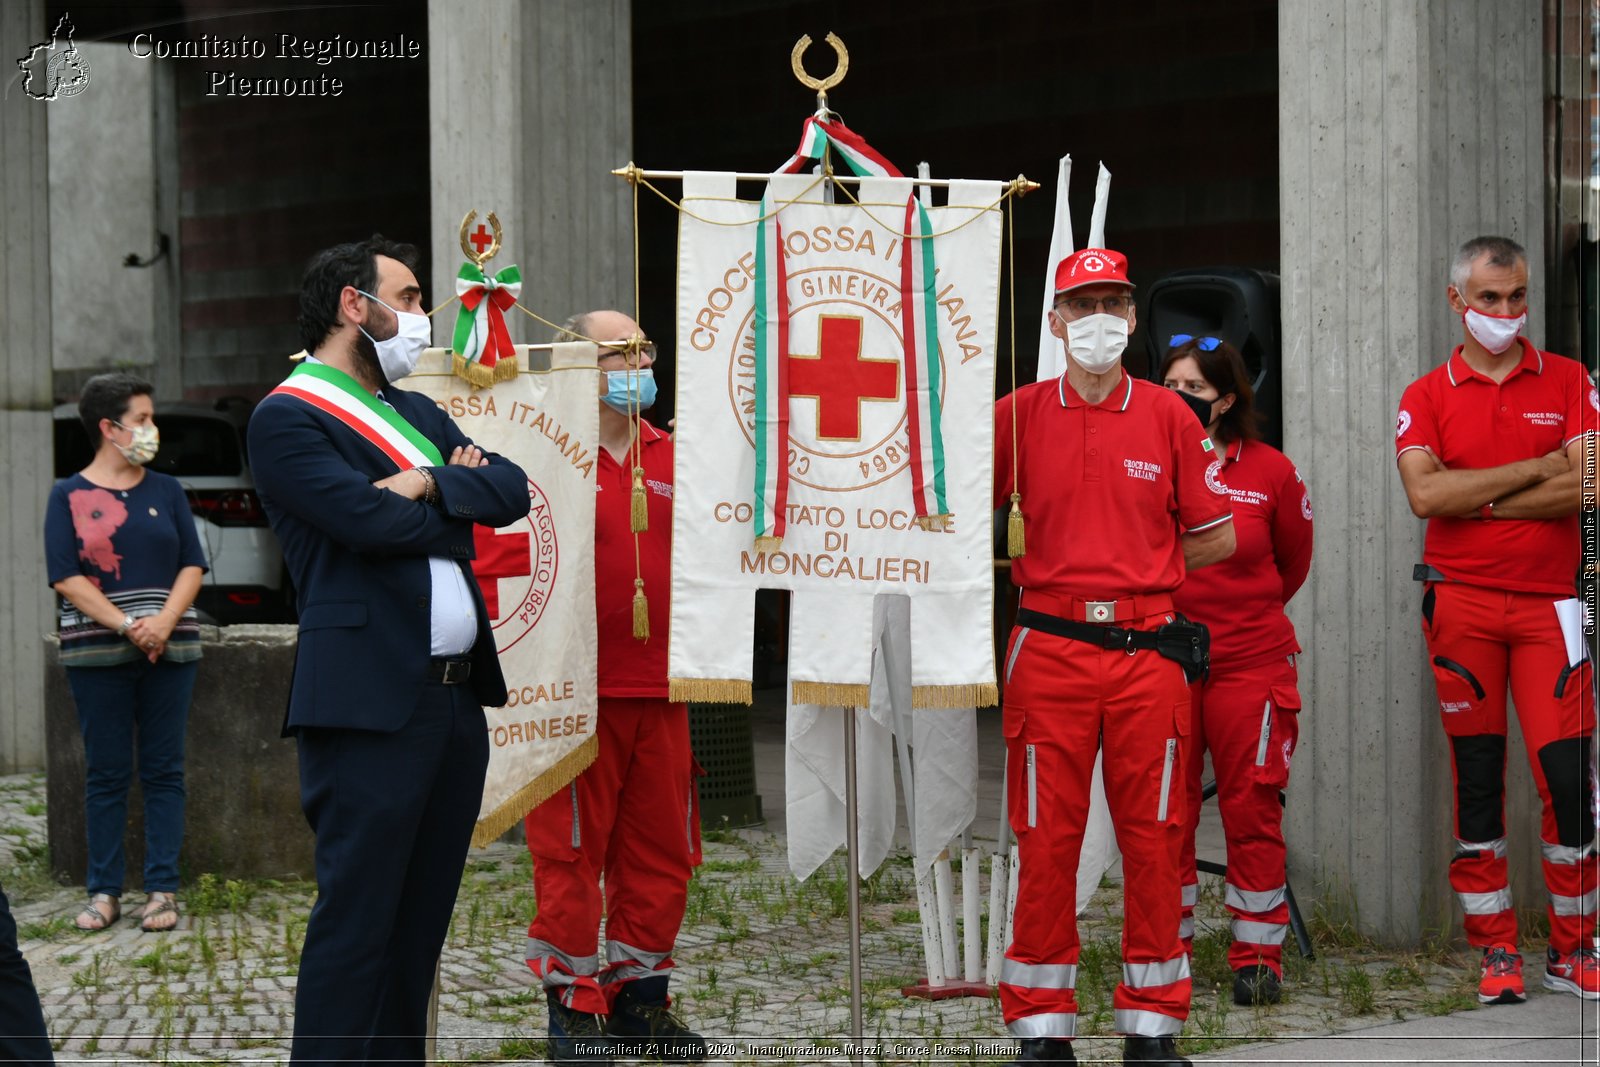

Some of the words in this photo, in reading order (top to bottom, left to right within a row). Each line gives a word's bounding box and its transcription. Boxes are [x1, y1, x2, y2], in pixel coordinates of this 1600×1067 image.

[690, 251, 756, 352] CROCE
[781, 225, 876, 259] OSSA
[801, 274, 902, 319] GINEVRA
[510, 401, 594, 479] ITALIANA
[1123, 458, 1144, 470] CROCE
[1144, 461, 1161, 474] ROSSA
[1127, 468, 1156, 482] ITALIANA
[1230, 495, 1260, 505] ITALIANA
[1247, 491, 1268, 502] ROSSA
[714, 501, 846, 529] COTATO
[530, 503, 553, 584] AGOSTO
[824, 530, 848, 553] DI
[740, 550, 930, 585] MONCALIERI
[519, 588, 545, 625] 1864
[498, 680, 575, 709] OCALE
[488, 713, 588, 748] ORINESE
